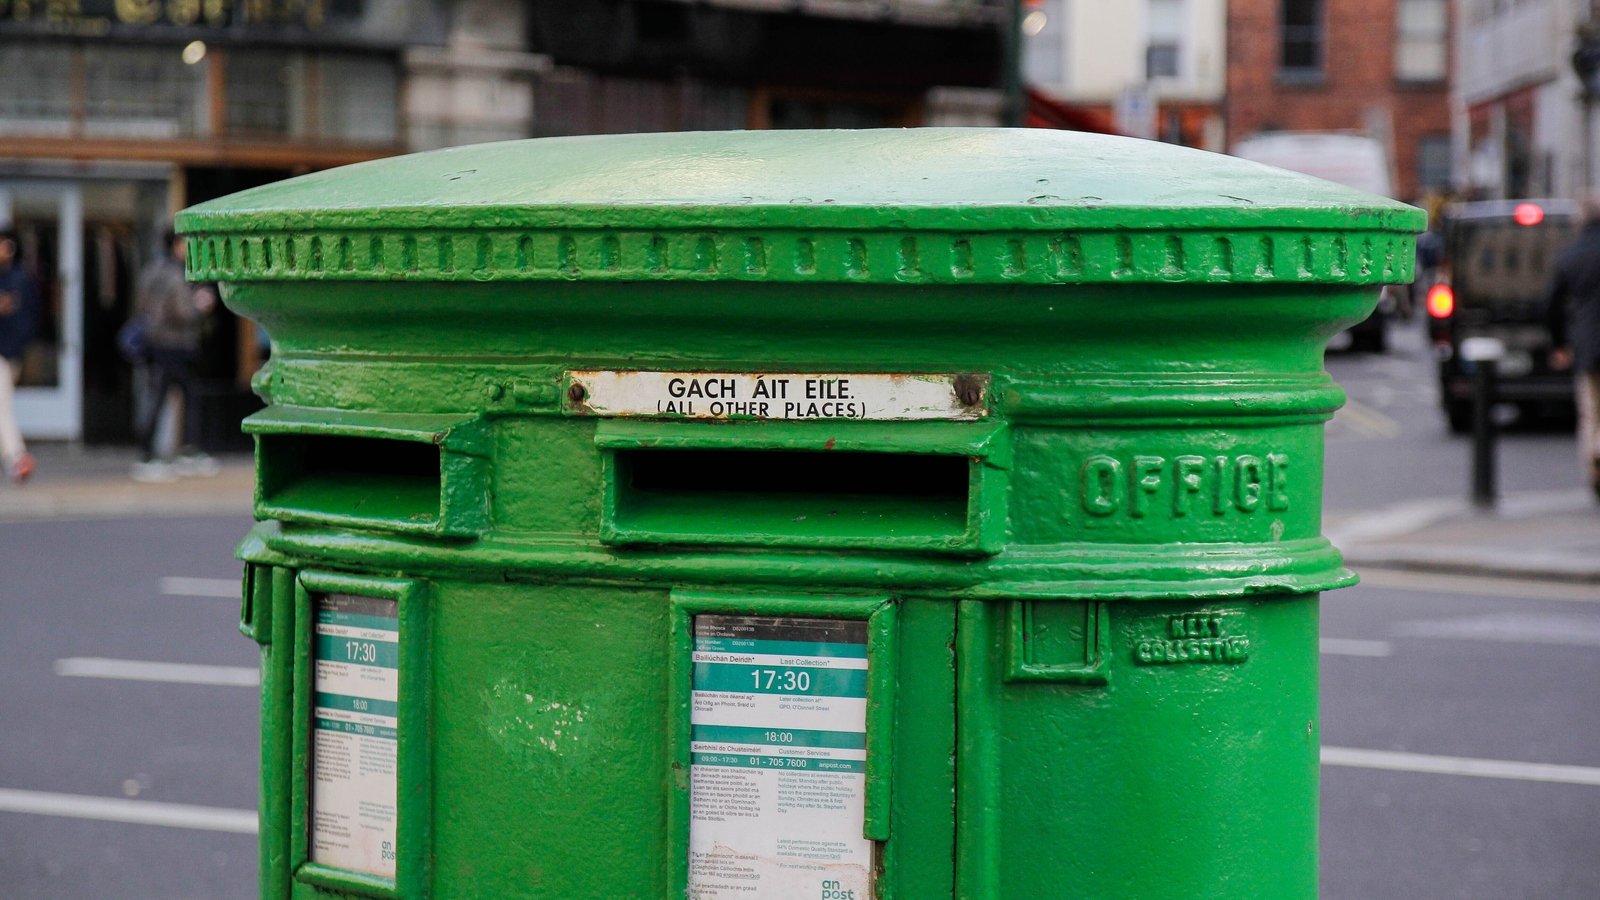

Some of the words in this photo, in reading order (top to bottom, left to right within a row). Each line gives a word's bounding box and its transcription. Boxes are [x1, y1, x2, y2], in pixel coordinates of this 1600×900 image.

[668, 378, 736, 399] GACH
[752, 374, 789, 399] ÁIT
[805, 378, 855, 400] EILE.
[657, 400, 695, 417] (ALL
[710, 401, 769, 418] OTHER
[785, 402, 866, 419] PLACES.)
[1080, 453, 1289, 517] OFFICE
[346, 641, 376, 663] 17:30
[695, 654, 728, 662] Bailiúchán
[751, 669, 810, 691] 17:30
[764, 732, 793, 742] 18:00
[778, 748, 806, 756] Customer
[807, 749, 830, 757] Services
[750, 758, 760, 766] 01
[769, 758, 784, 767] 705
[786, 759, 807, 768] 7600
[819, 762, 852, 770] anpost.com
[382, 840, 391, 850] an
[381, 850, 395, 861] pos
[822, 880, 840, 889] an
[822, 889, 854, 900] post
